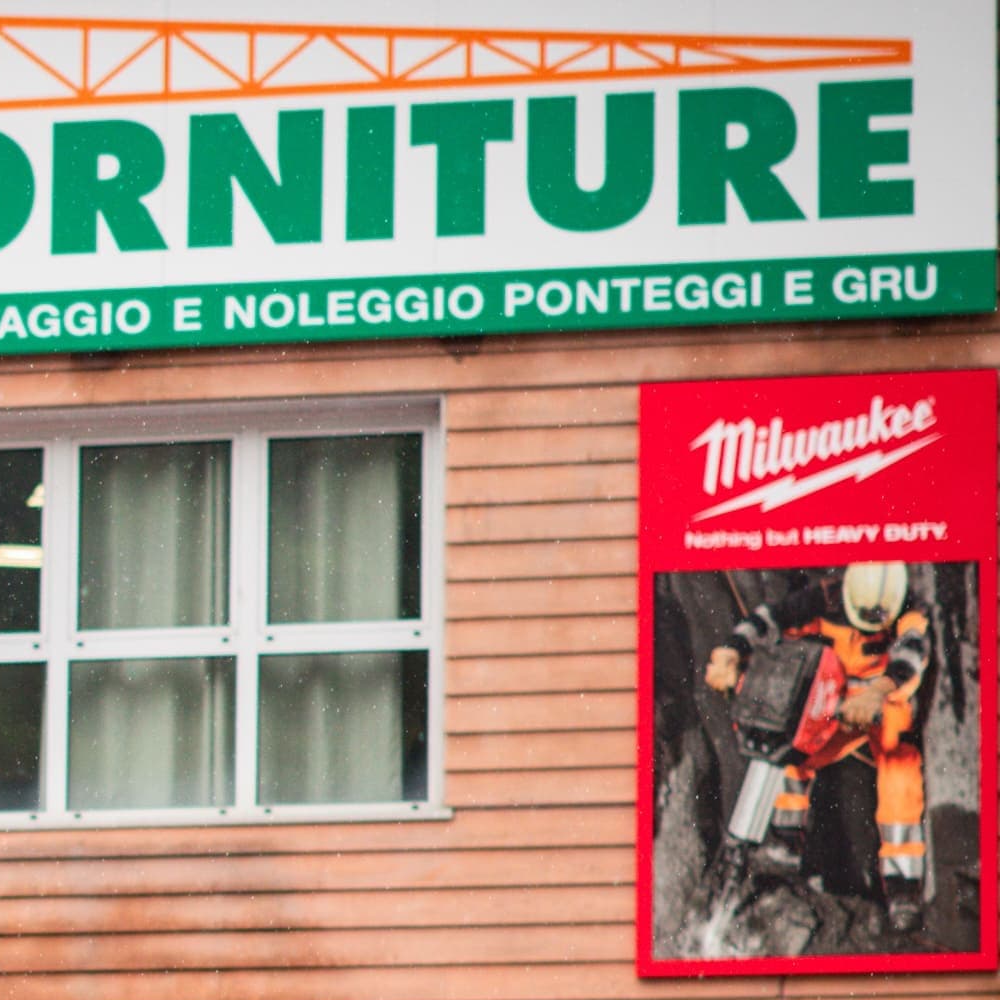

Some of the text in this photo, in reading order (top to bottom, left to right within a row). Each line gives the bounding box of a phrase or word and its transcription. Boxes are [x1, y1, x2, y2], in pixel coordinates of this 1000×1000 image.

[173, 297, 203, 332] E
[224, 284, 484, 330] NOLEGGIO
[504, 272, 762, 318] PONTEGGI
[784, 269, 814, 305] E
[832, 264, 938, 304] GRU
[689, 395, 938, 496] Milwaukee
[684, 530, 763, 551] Nothing
[765, 528, 799, 547] but
[802, 524, 881, 545] HEAVY
